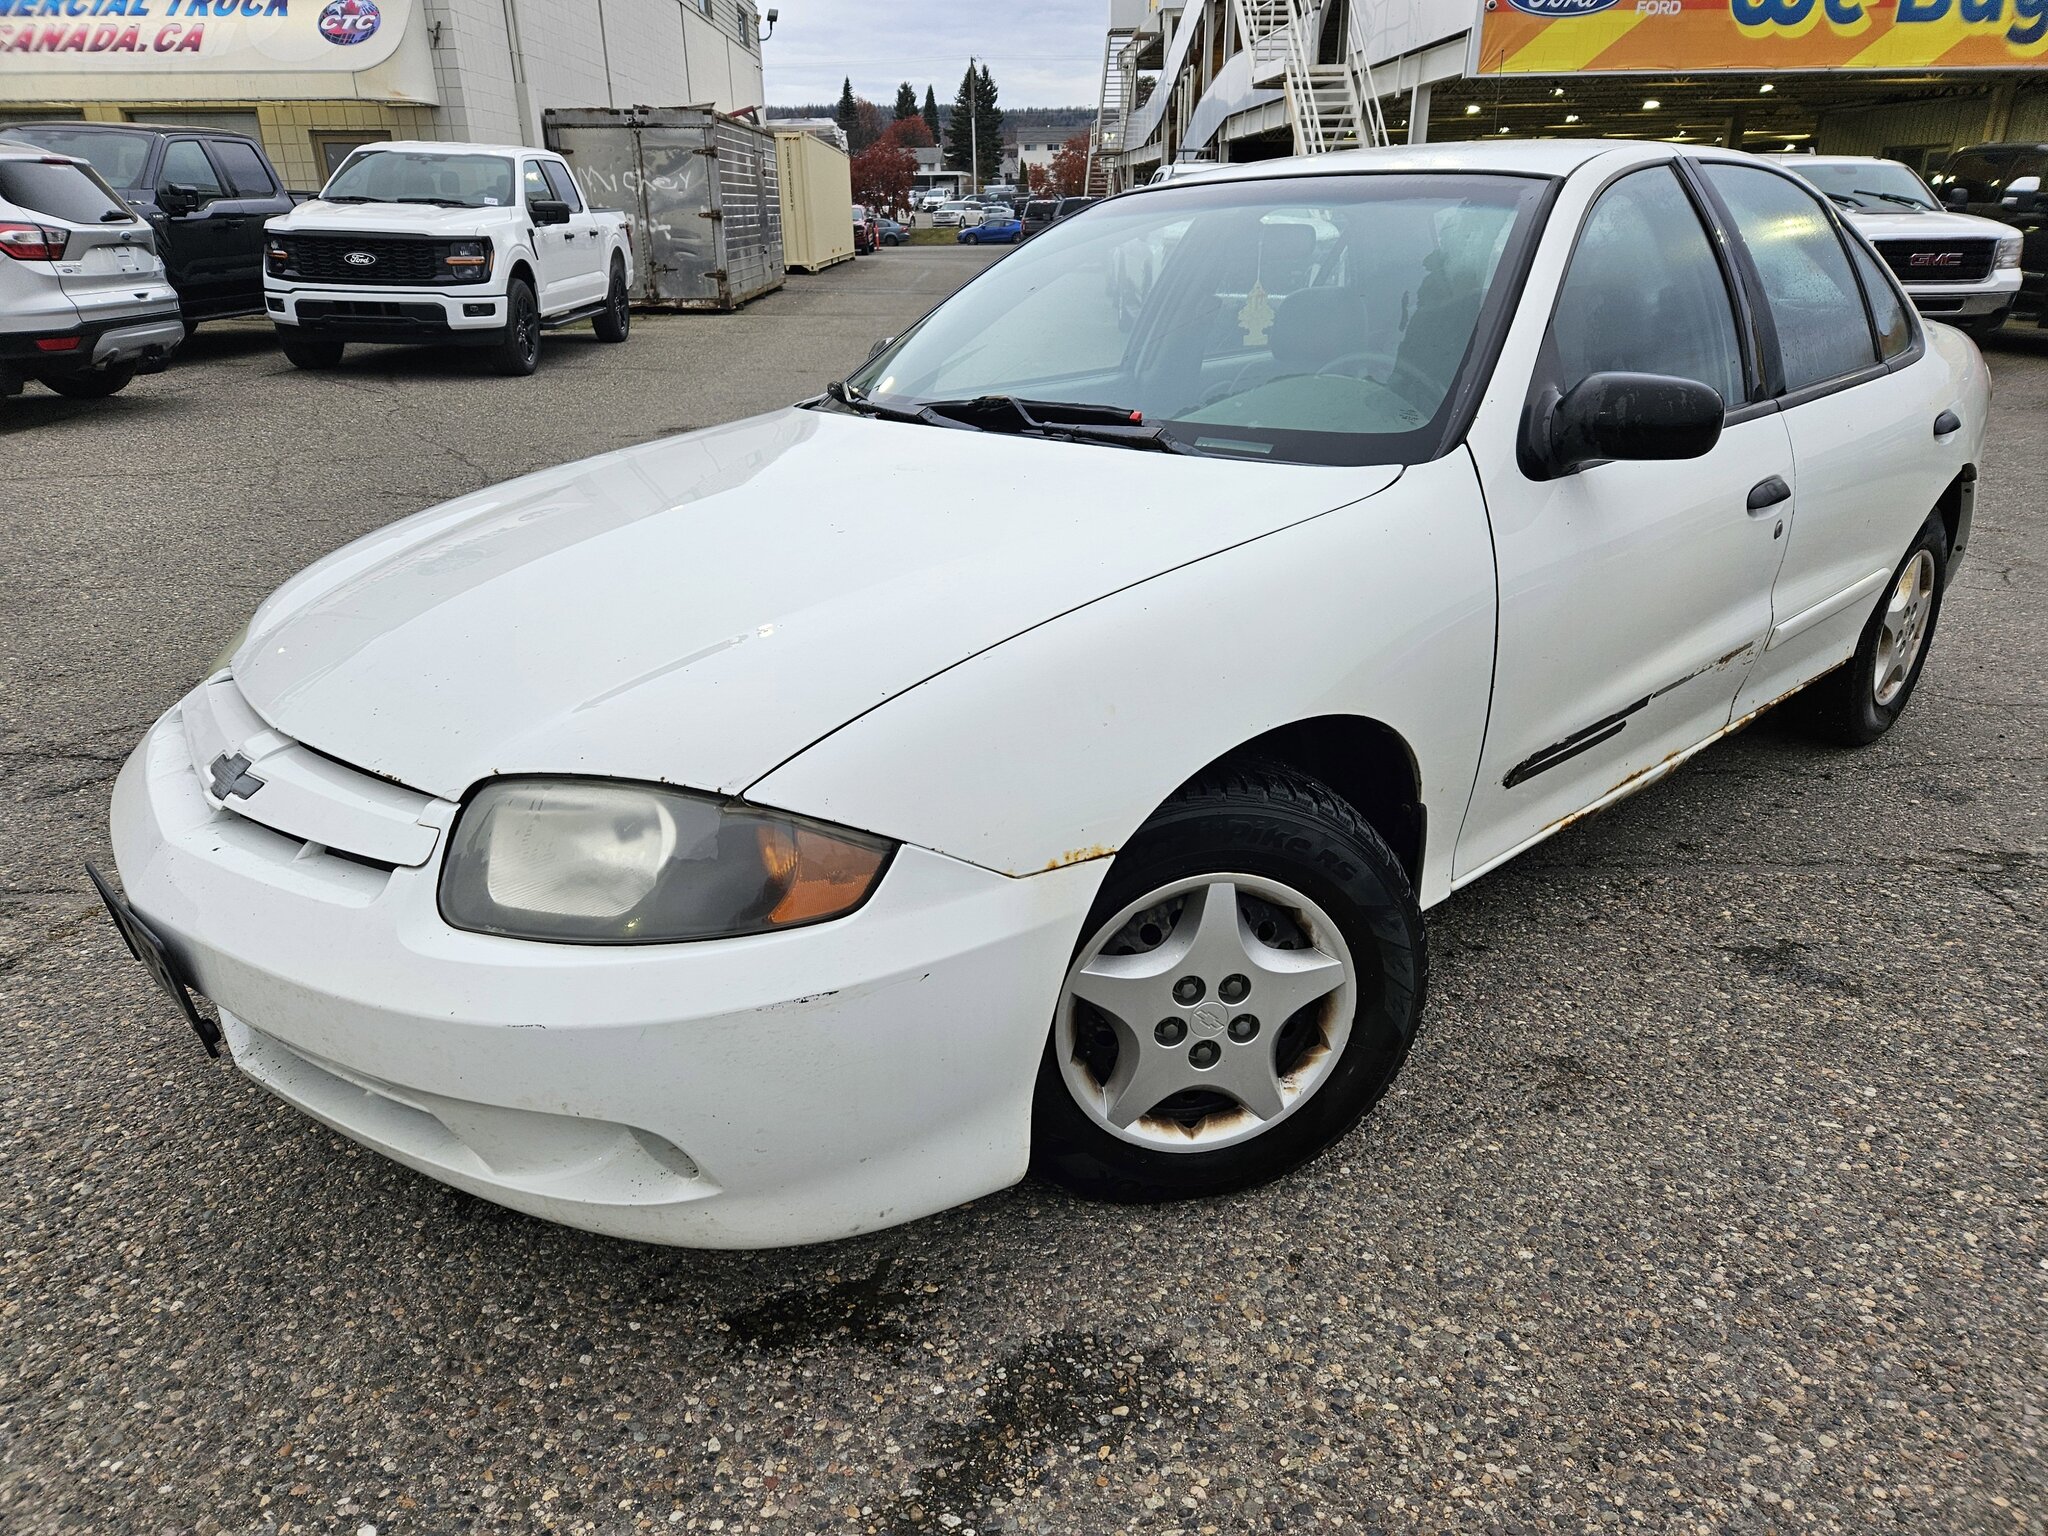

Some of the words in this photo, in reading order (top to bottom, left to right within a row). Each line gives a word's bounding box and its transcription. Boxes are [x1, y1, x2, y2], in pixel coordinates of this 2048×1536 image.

[1635, 0, 1682, 15] FORD
[321, 14, 376, 30] CTC
[348, 253, 372, 265] Ford
[1910, 252, 1964, 266] GMC
